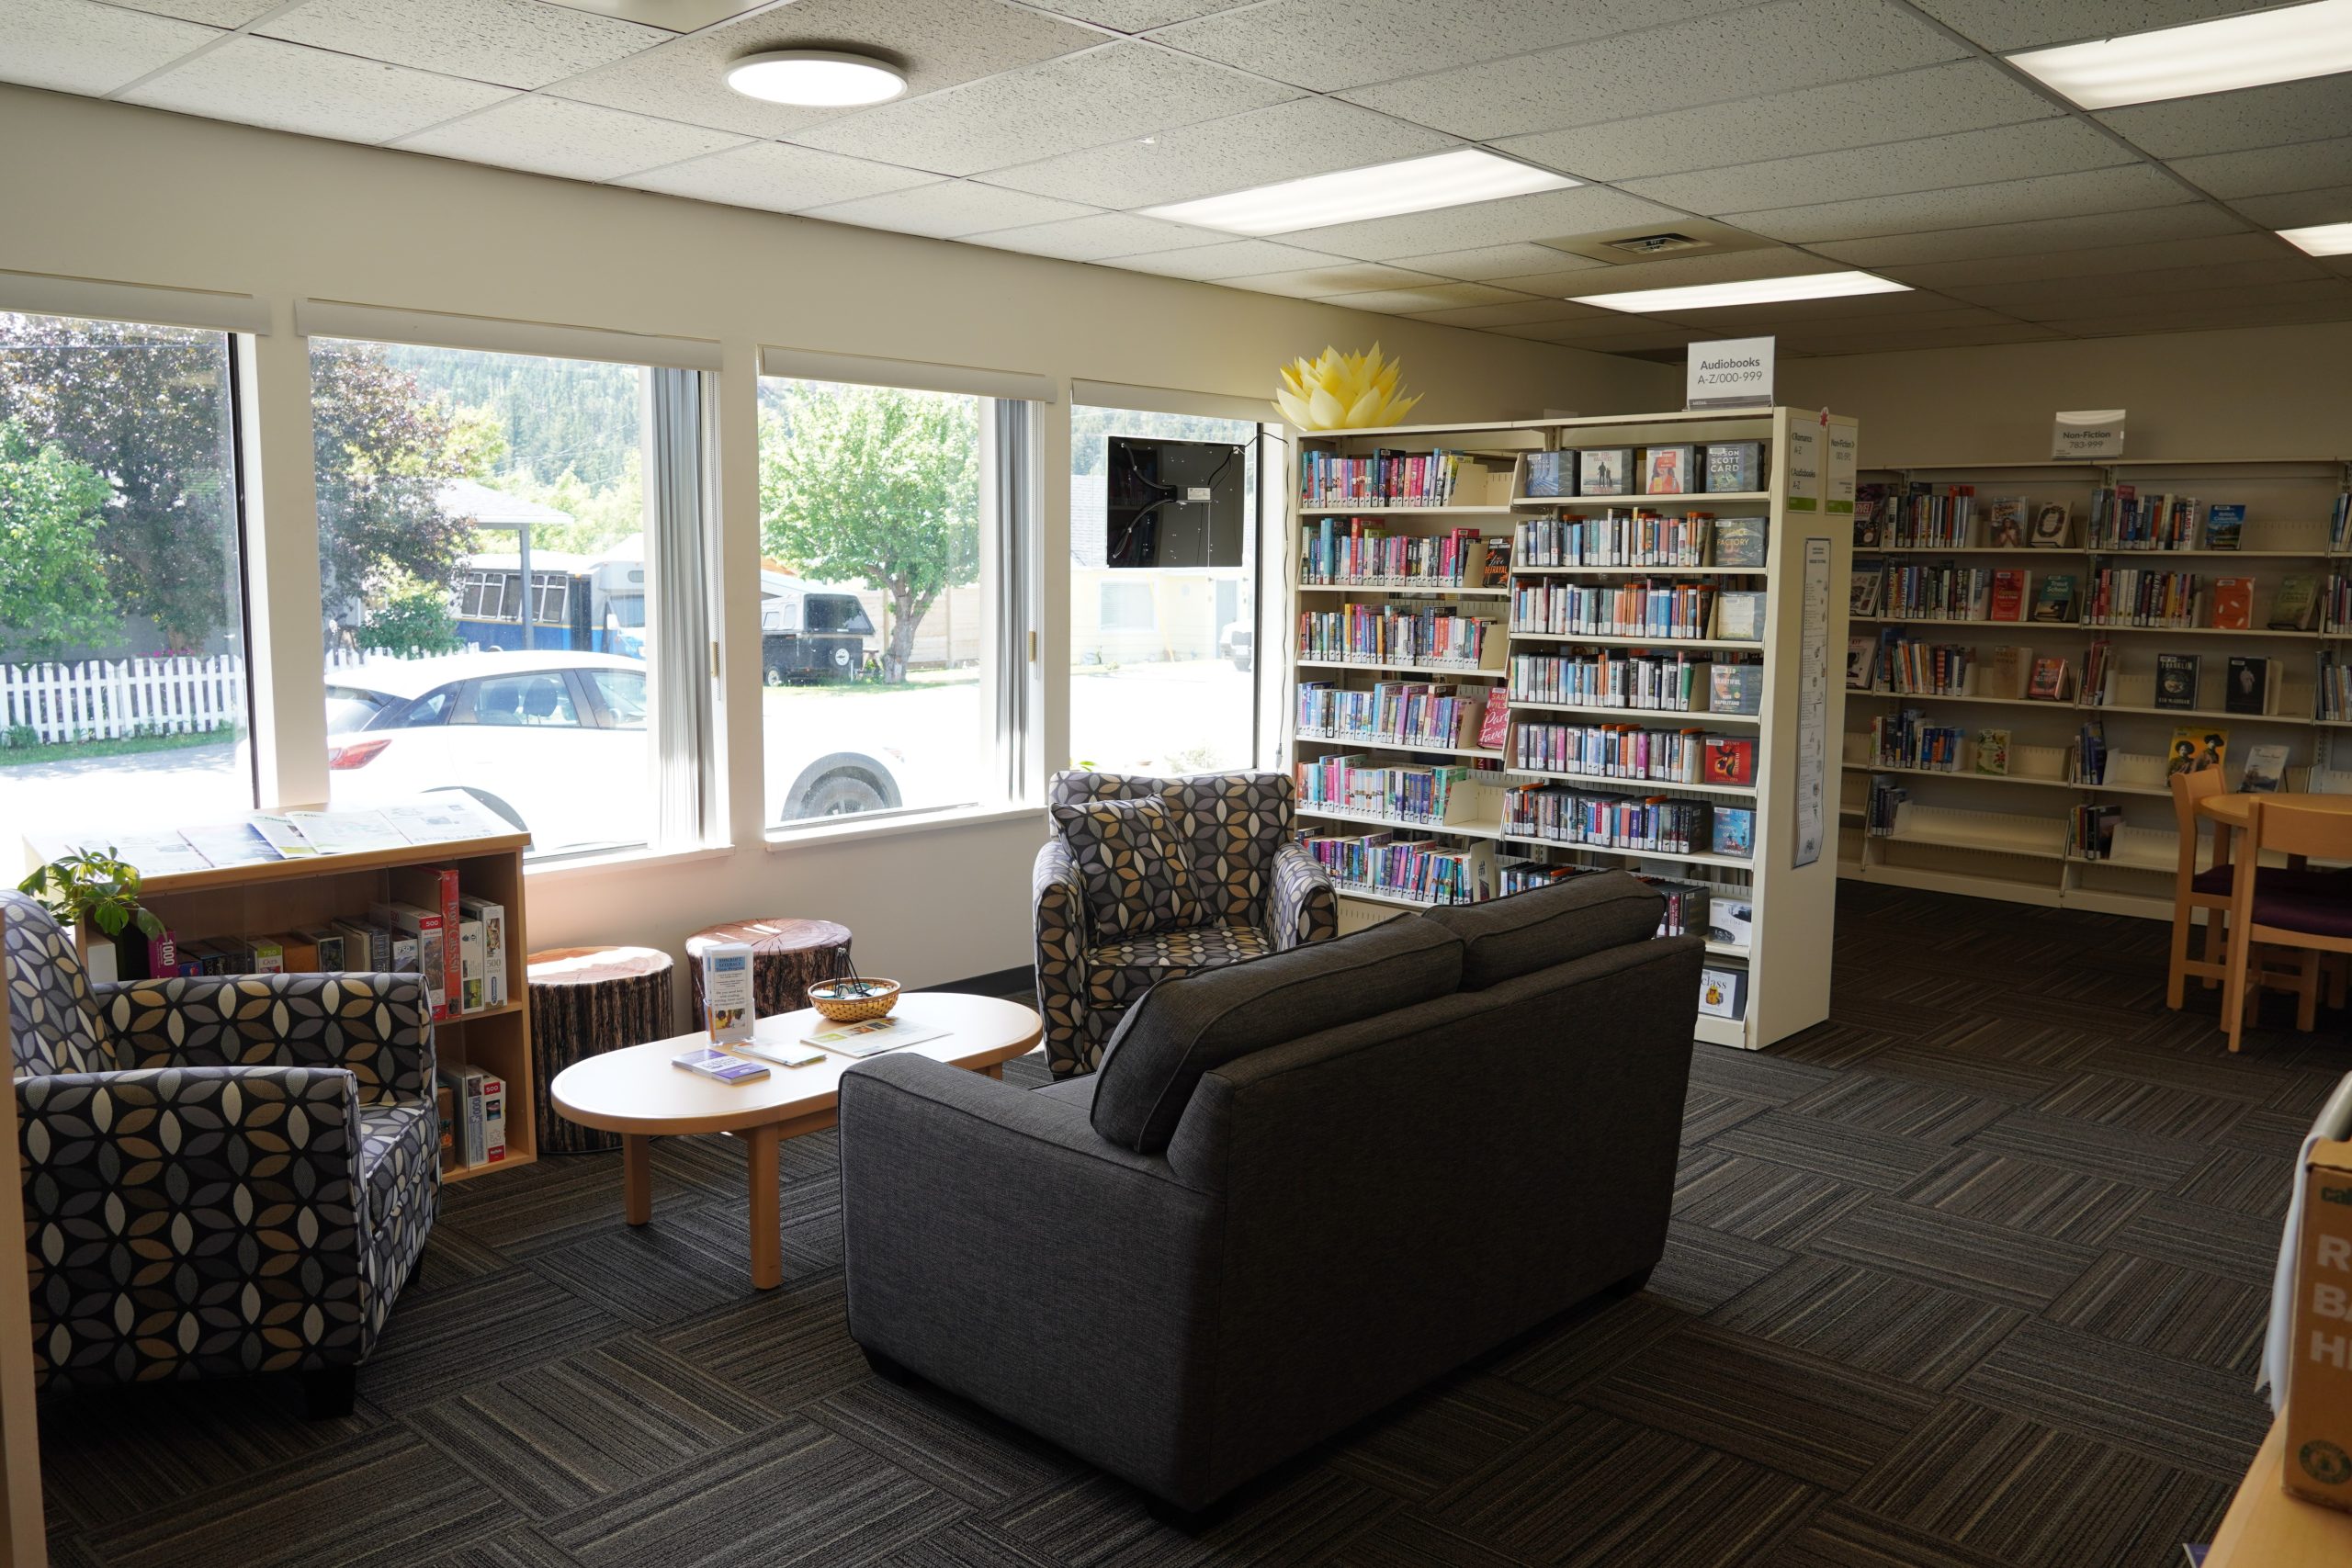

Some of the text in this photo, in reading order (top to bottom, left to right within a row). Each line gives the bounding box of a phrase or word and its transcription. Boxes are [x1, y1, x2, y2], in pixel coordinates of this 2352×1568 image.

[1701, 357, 1760, 370] Audiobooks
[1698, 371, 1762, 384] A-Z/000-999
[2063, 431, 2110, 439] Non-Fiction
[1831, 438, 1851, 449] Non-Fiction
[2069, 441, 2103, 449] 783-999
[1711, 464, 1739, 472] CARD
[1793, 468, 1815, 479] Audiobooks
[1856, 503, 1871, 514] RVEL
[1485, 566, 1508, 574] BETRAYAL
[2161, 661, 2192, 671] FRANKLIN
[163, 940, 175, 966] 1000
[398, 946, 411, 955] 750
[486, 959, 501, 967] 500
[1701, 976, 1726, 989] class
[2316, 1234, 2352, 1272] R
